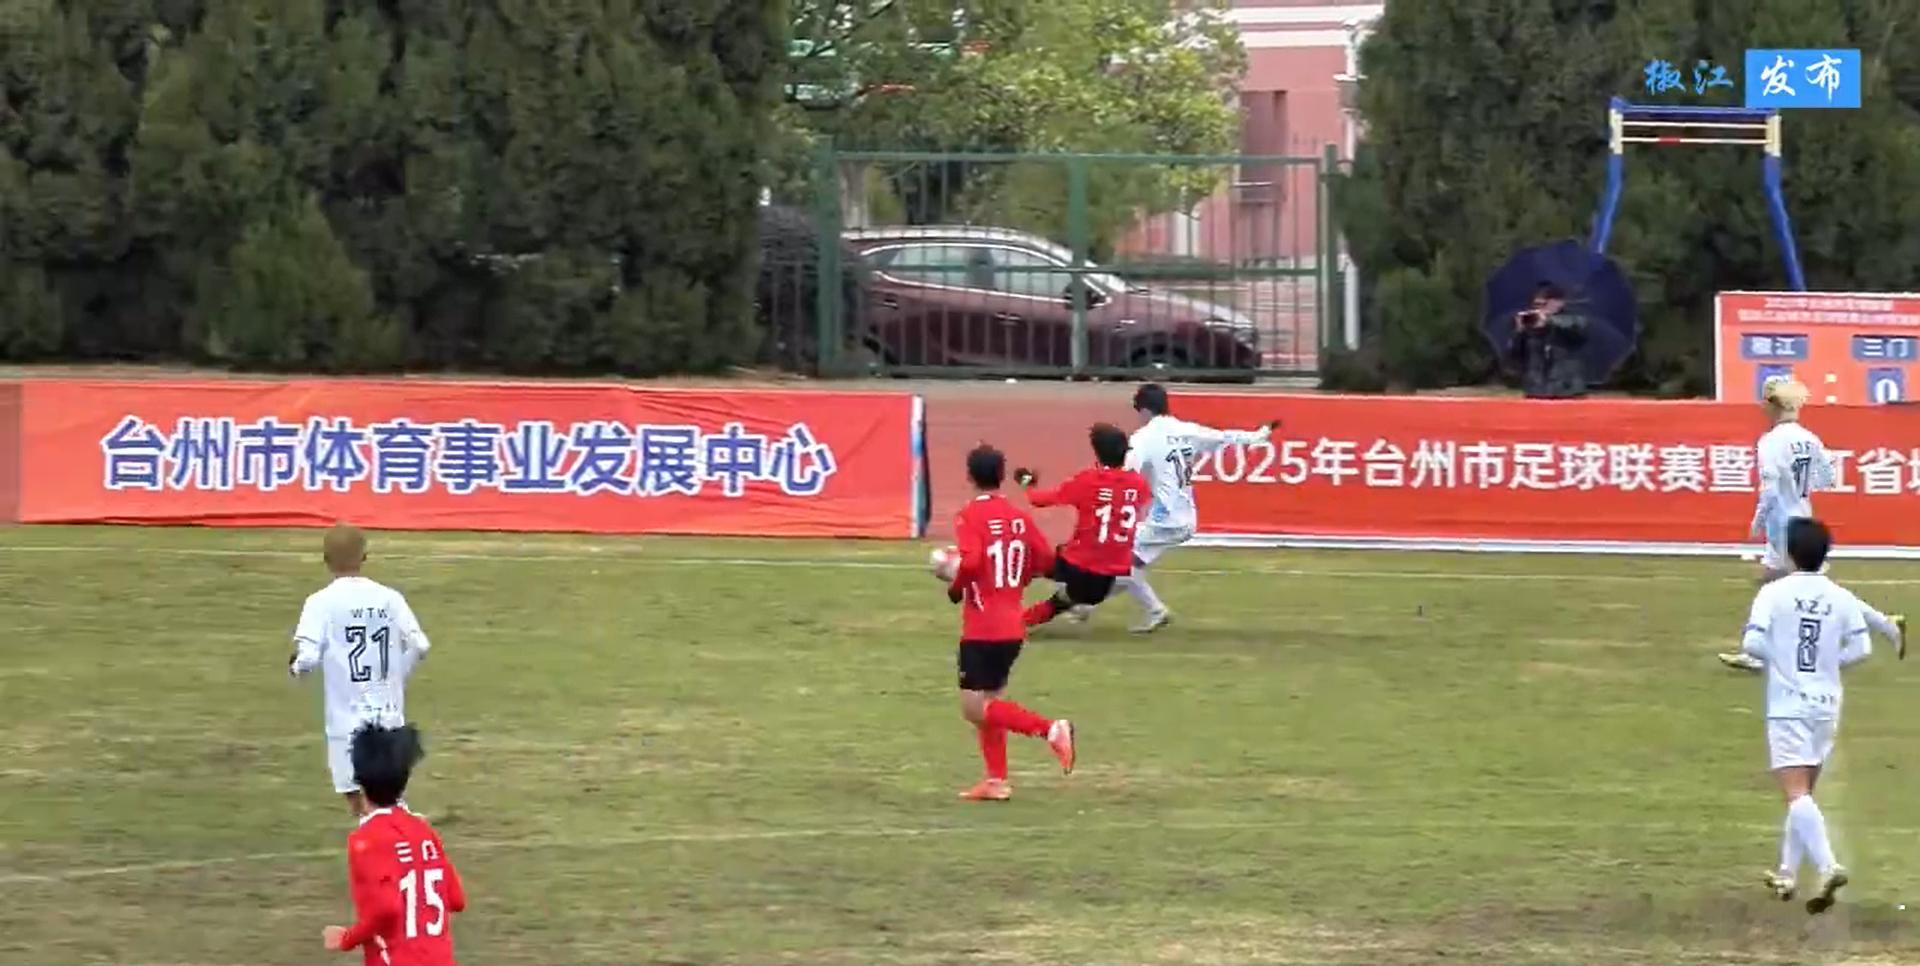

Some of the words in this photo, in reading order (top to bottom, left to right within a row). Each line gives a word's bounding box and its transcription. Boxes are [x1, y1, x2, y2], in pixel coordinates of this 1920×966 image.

[100, 414, 837, 496] 台州市体育事业发展中心
[1096, 504, 1136, 544] 13
[986, 539, 1026, 588] 10
[345, 626, 390, 683] 21
[1798, 618, 1821, 673] 8
[399, 868, 444, 938] 15
